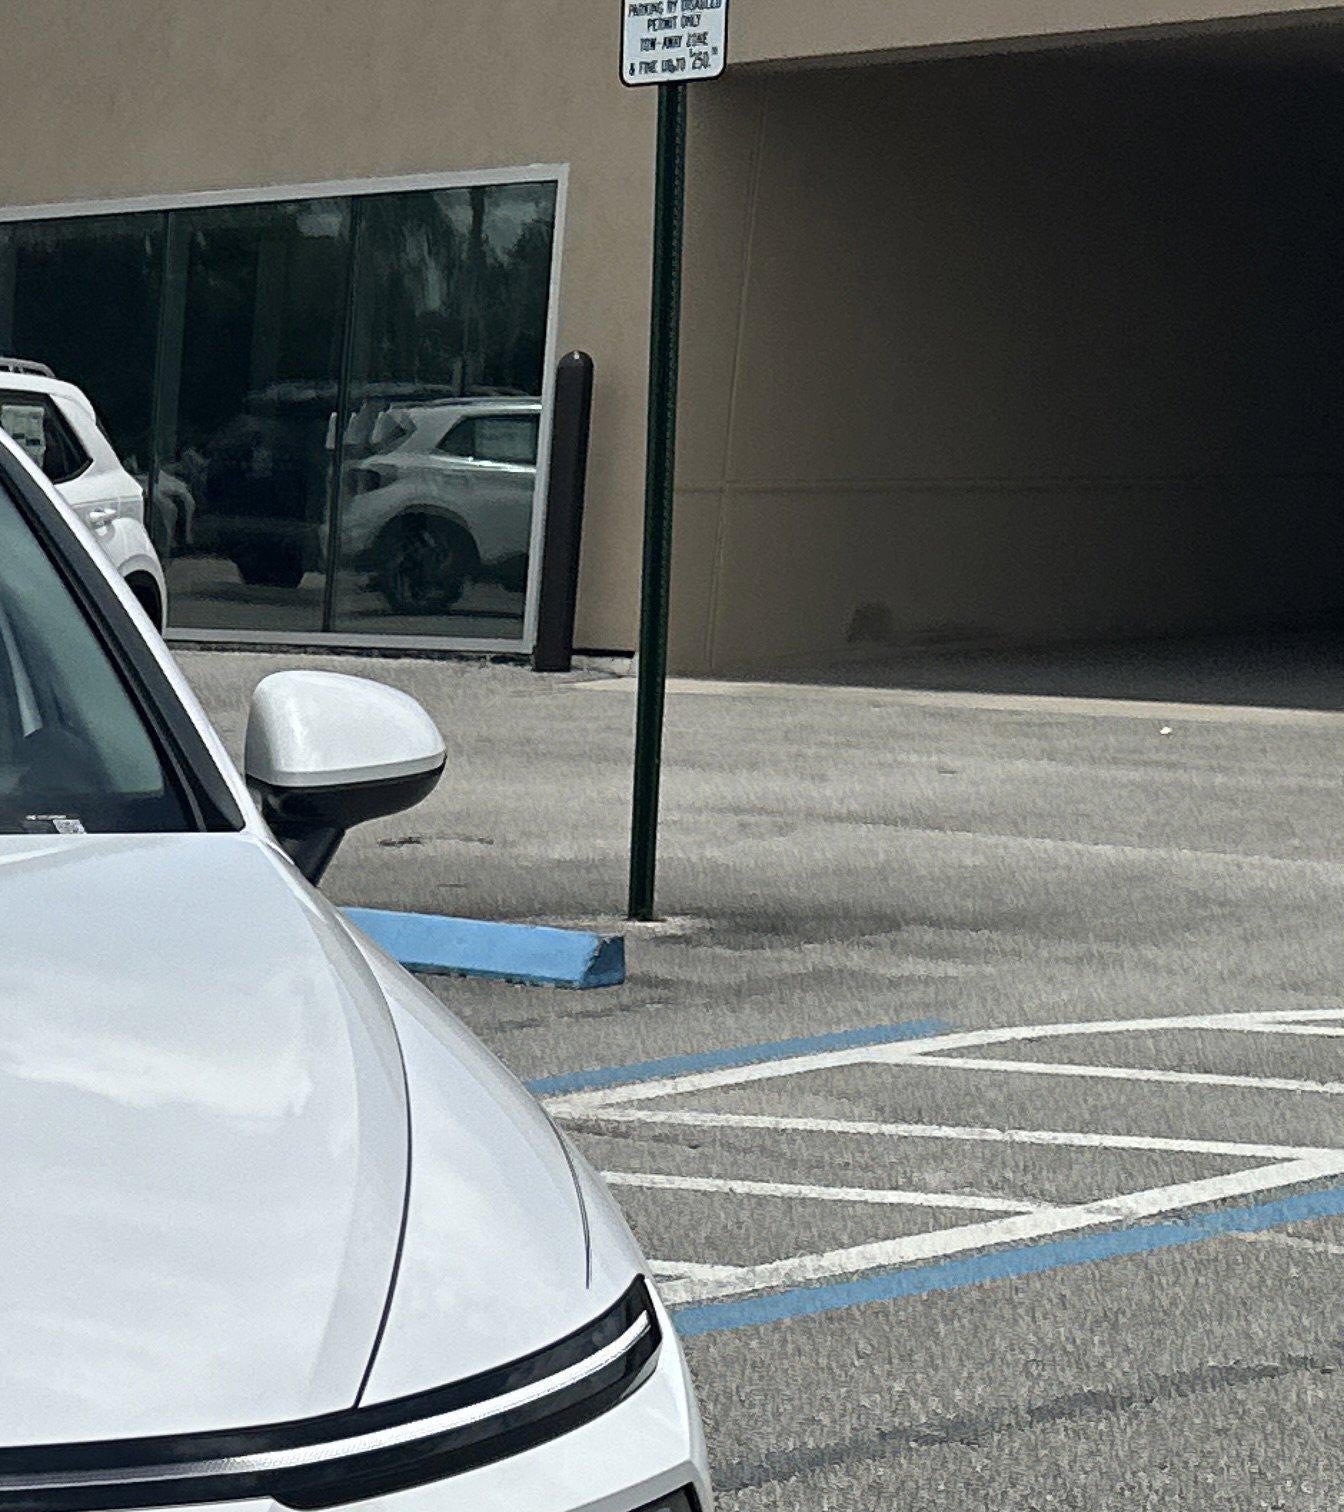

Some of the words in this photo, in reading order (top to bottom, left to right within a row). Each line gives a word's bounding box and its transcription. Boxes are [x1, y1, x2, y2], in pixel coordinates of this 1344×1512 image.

[628, 1, 664, 16] PARKING
[647, 16, 678, 31] PERMIT
[680, 13, 701, 29] ONLY
